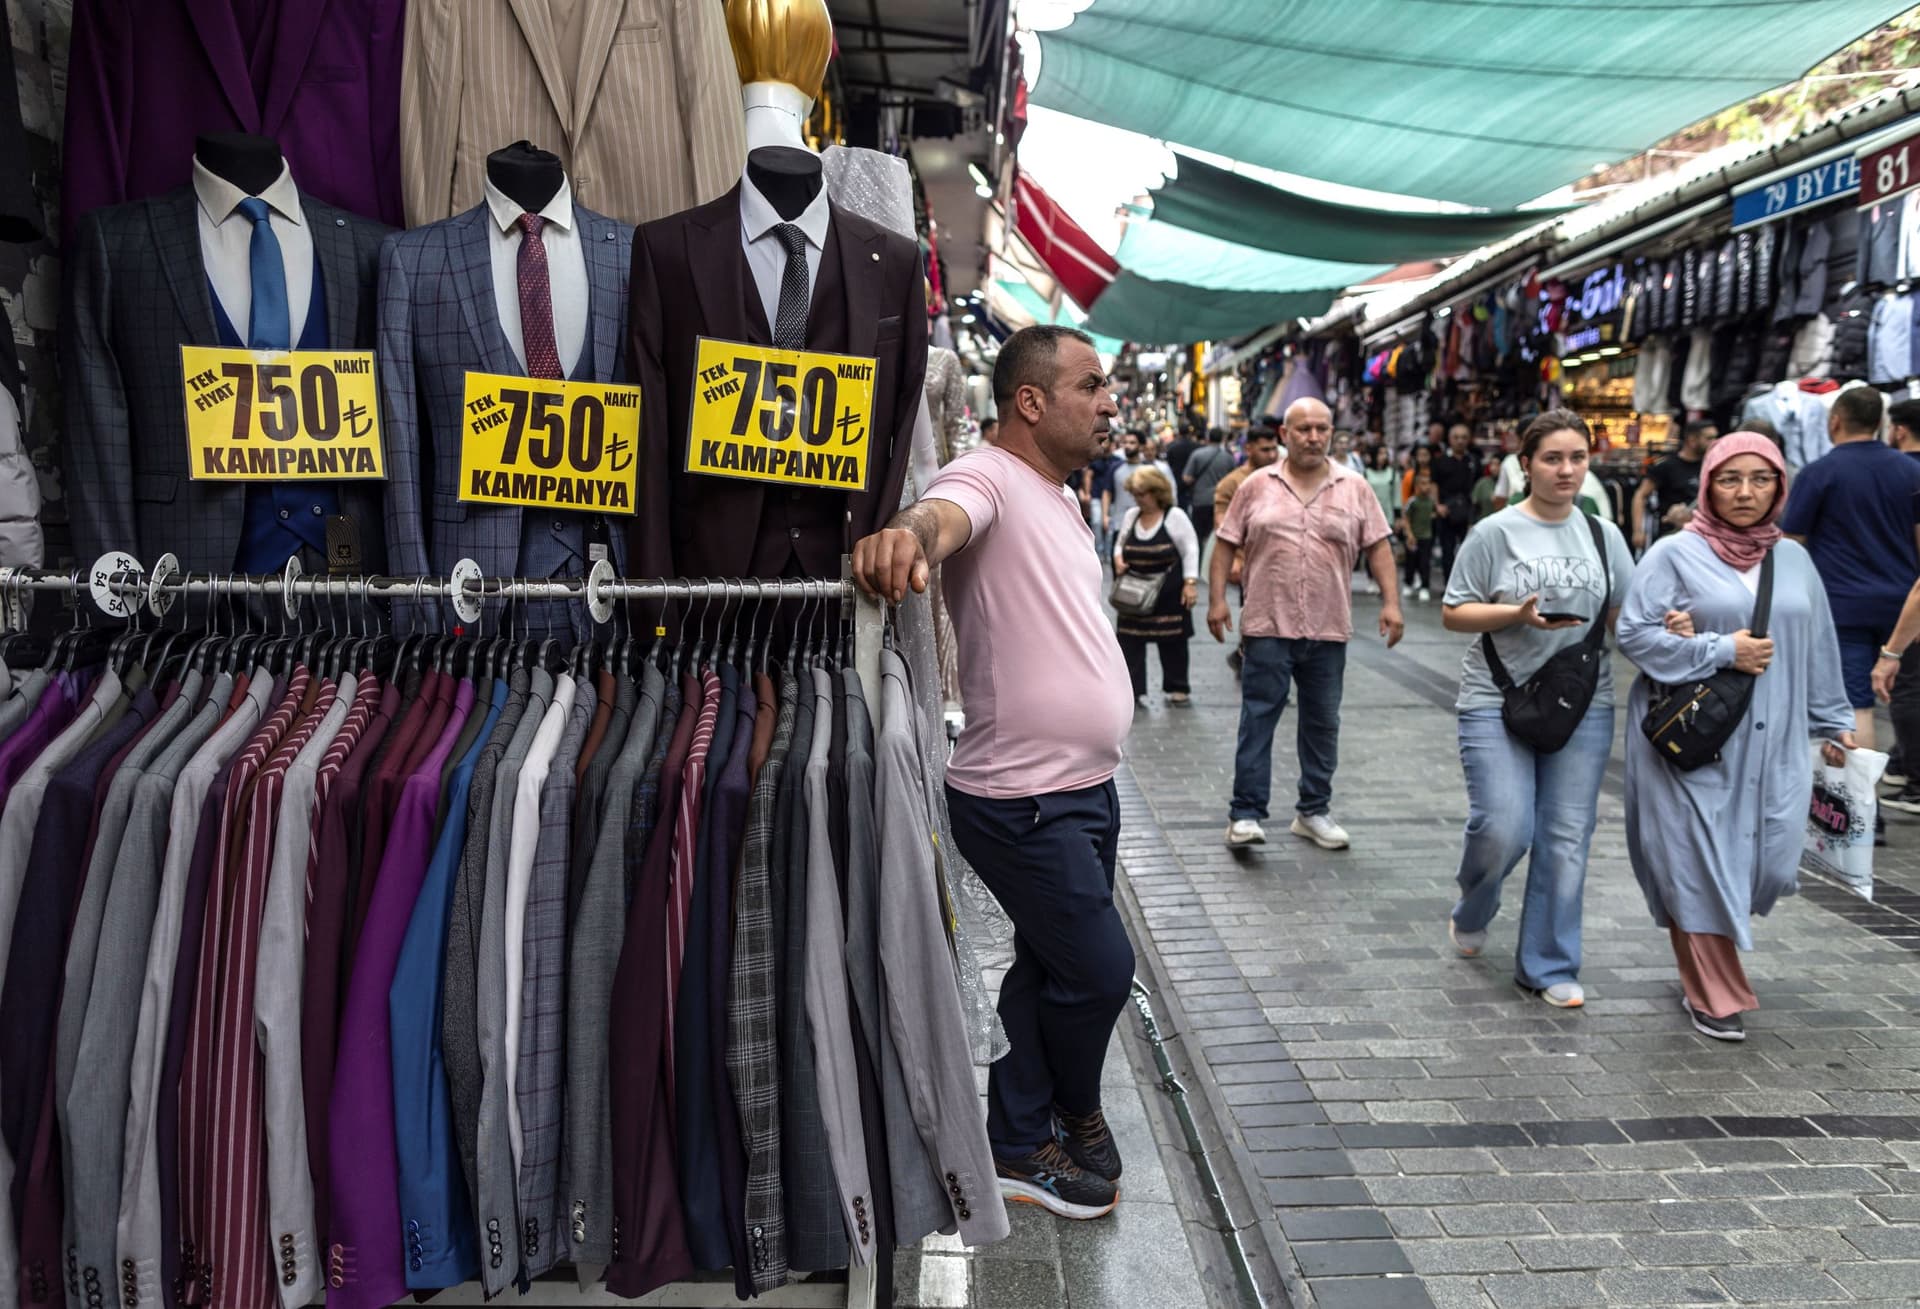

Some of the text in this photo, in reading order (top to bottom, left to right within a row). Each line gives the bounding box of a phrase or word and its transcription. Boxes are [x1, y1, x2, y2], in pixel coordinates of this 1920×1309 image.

[1876, 145, 1910, 194] 81
[1764, 181, 1788, 214] 79
[1796, 165, 1833, 203] BY
[334, 357, 370, 374] NAKİT
[699, 362, 730, 385] TEK
[837, 362, 873, 381] NAKİT
[187, 368, 220, 392] TEK
[702, 377, 741, 405] FİYAT
[194, 382, 235, 412] FİYAT
[466, 393, 497, 416] TEK
[604, 391, 639, 408] NAKİT
[471, 408, 509, 435] FİYAT
[203, 447, 377, 474] KAMPANYA
[700, 439, 859, 483] KAMPANYA
[471, 469, 629, 508] KAMPANYA
[94, 571, 107, 588] 54
[1513, 556, 1603, 600] NIKE
[109, 599, 123, 613] 54
